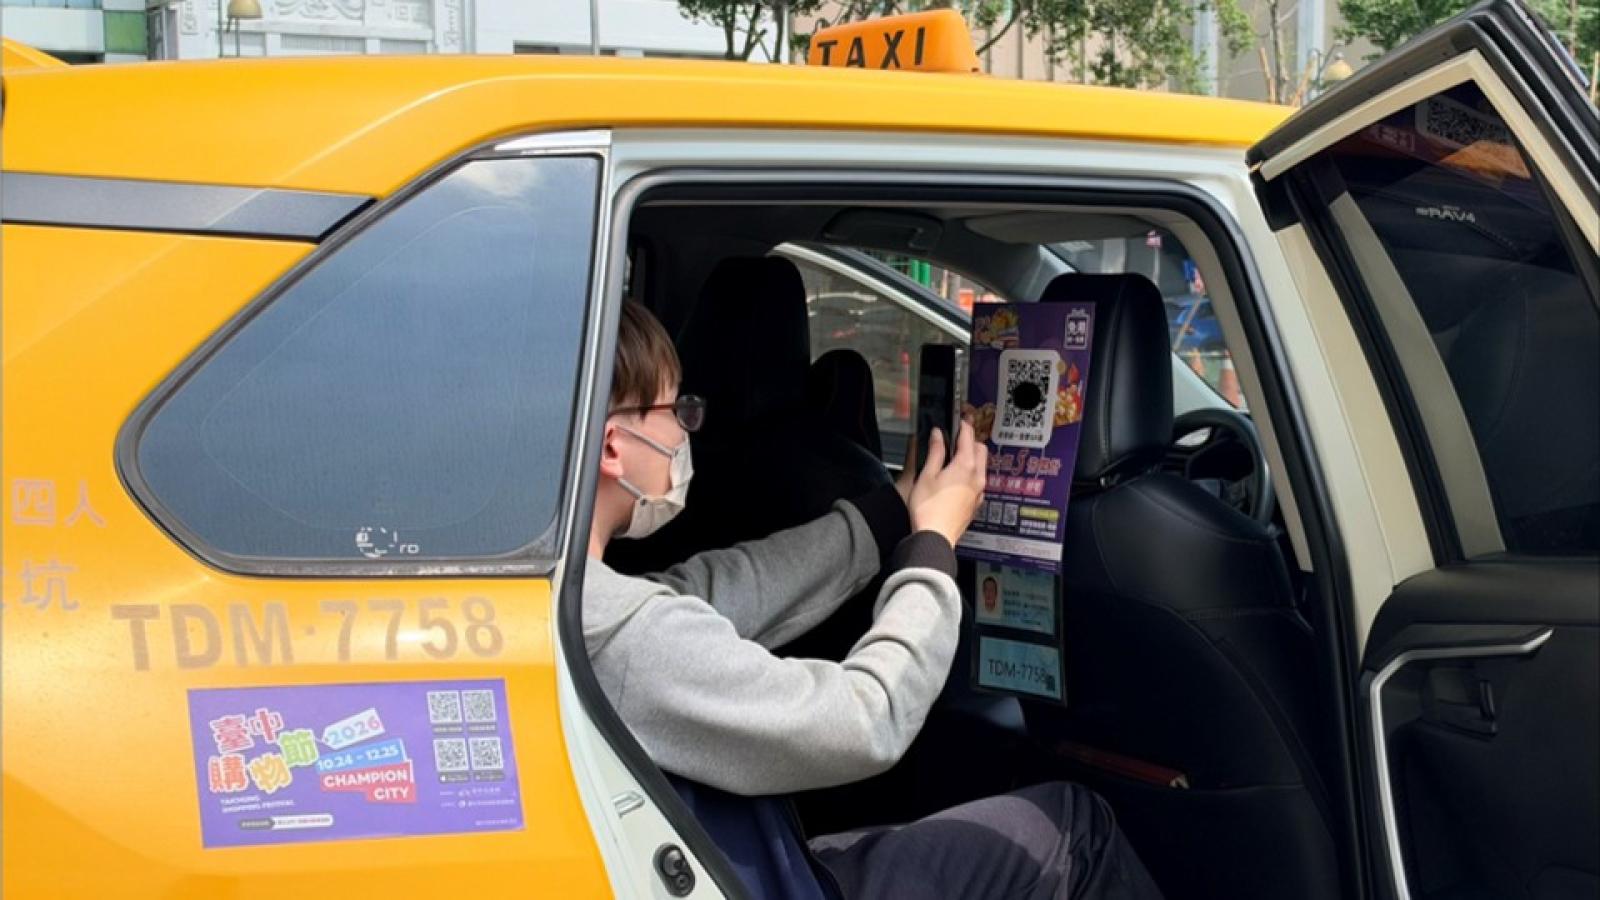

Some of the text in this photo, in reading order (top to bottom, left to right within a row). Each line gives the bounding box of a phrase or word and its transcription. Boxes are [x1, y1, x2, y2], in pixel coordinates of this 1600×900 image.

[817, 27, 926, 70] TAXI
[0, 560, 81, 613] 坑
[327, 715, 382, 745] 2026
[323, 769, 408, 788] CHAMPION
[374, 786, 410, 801] CITY
